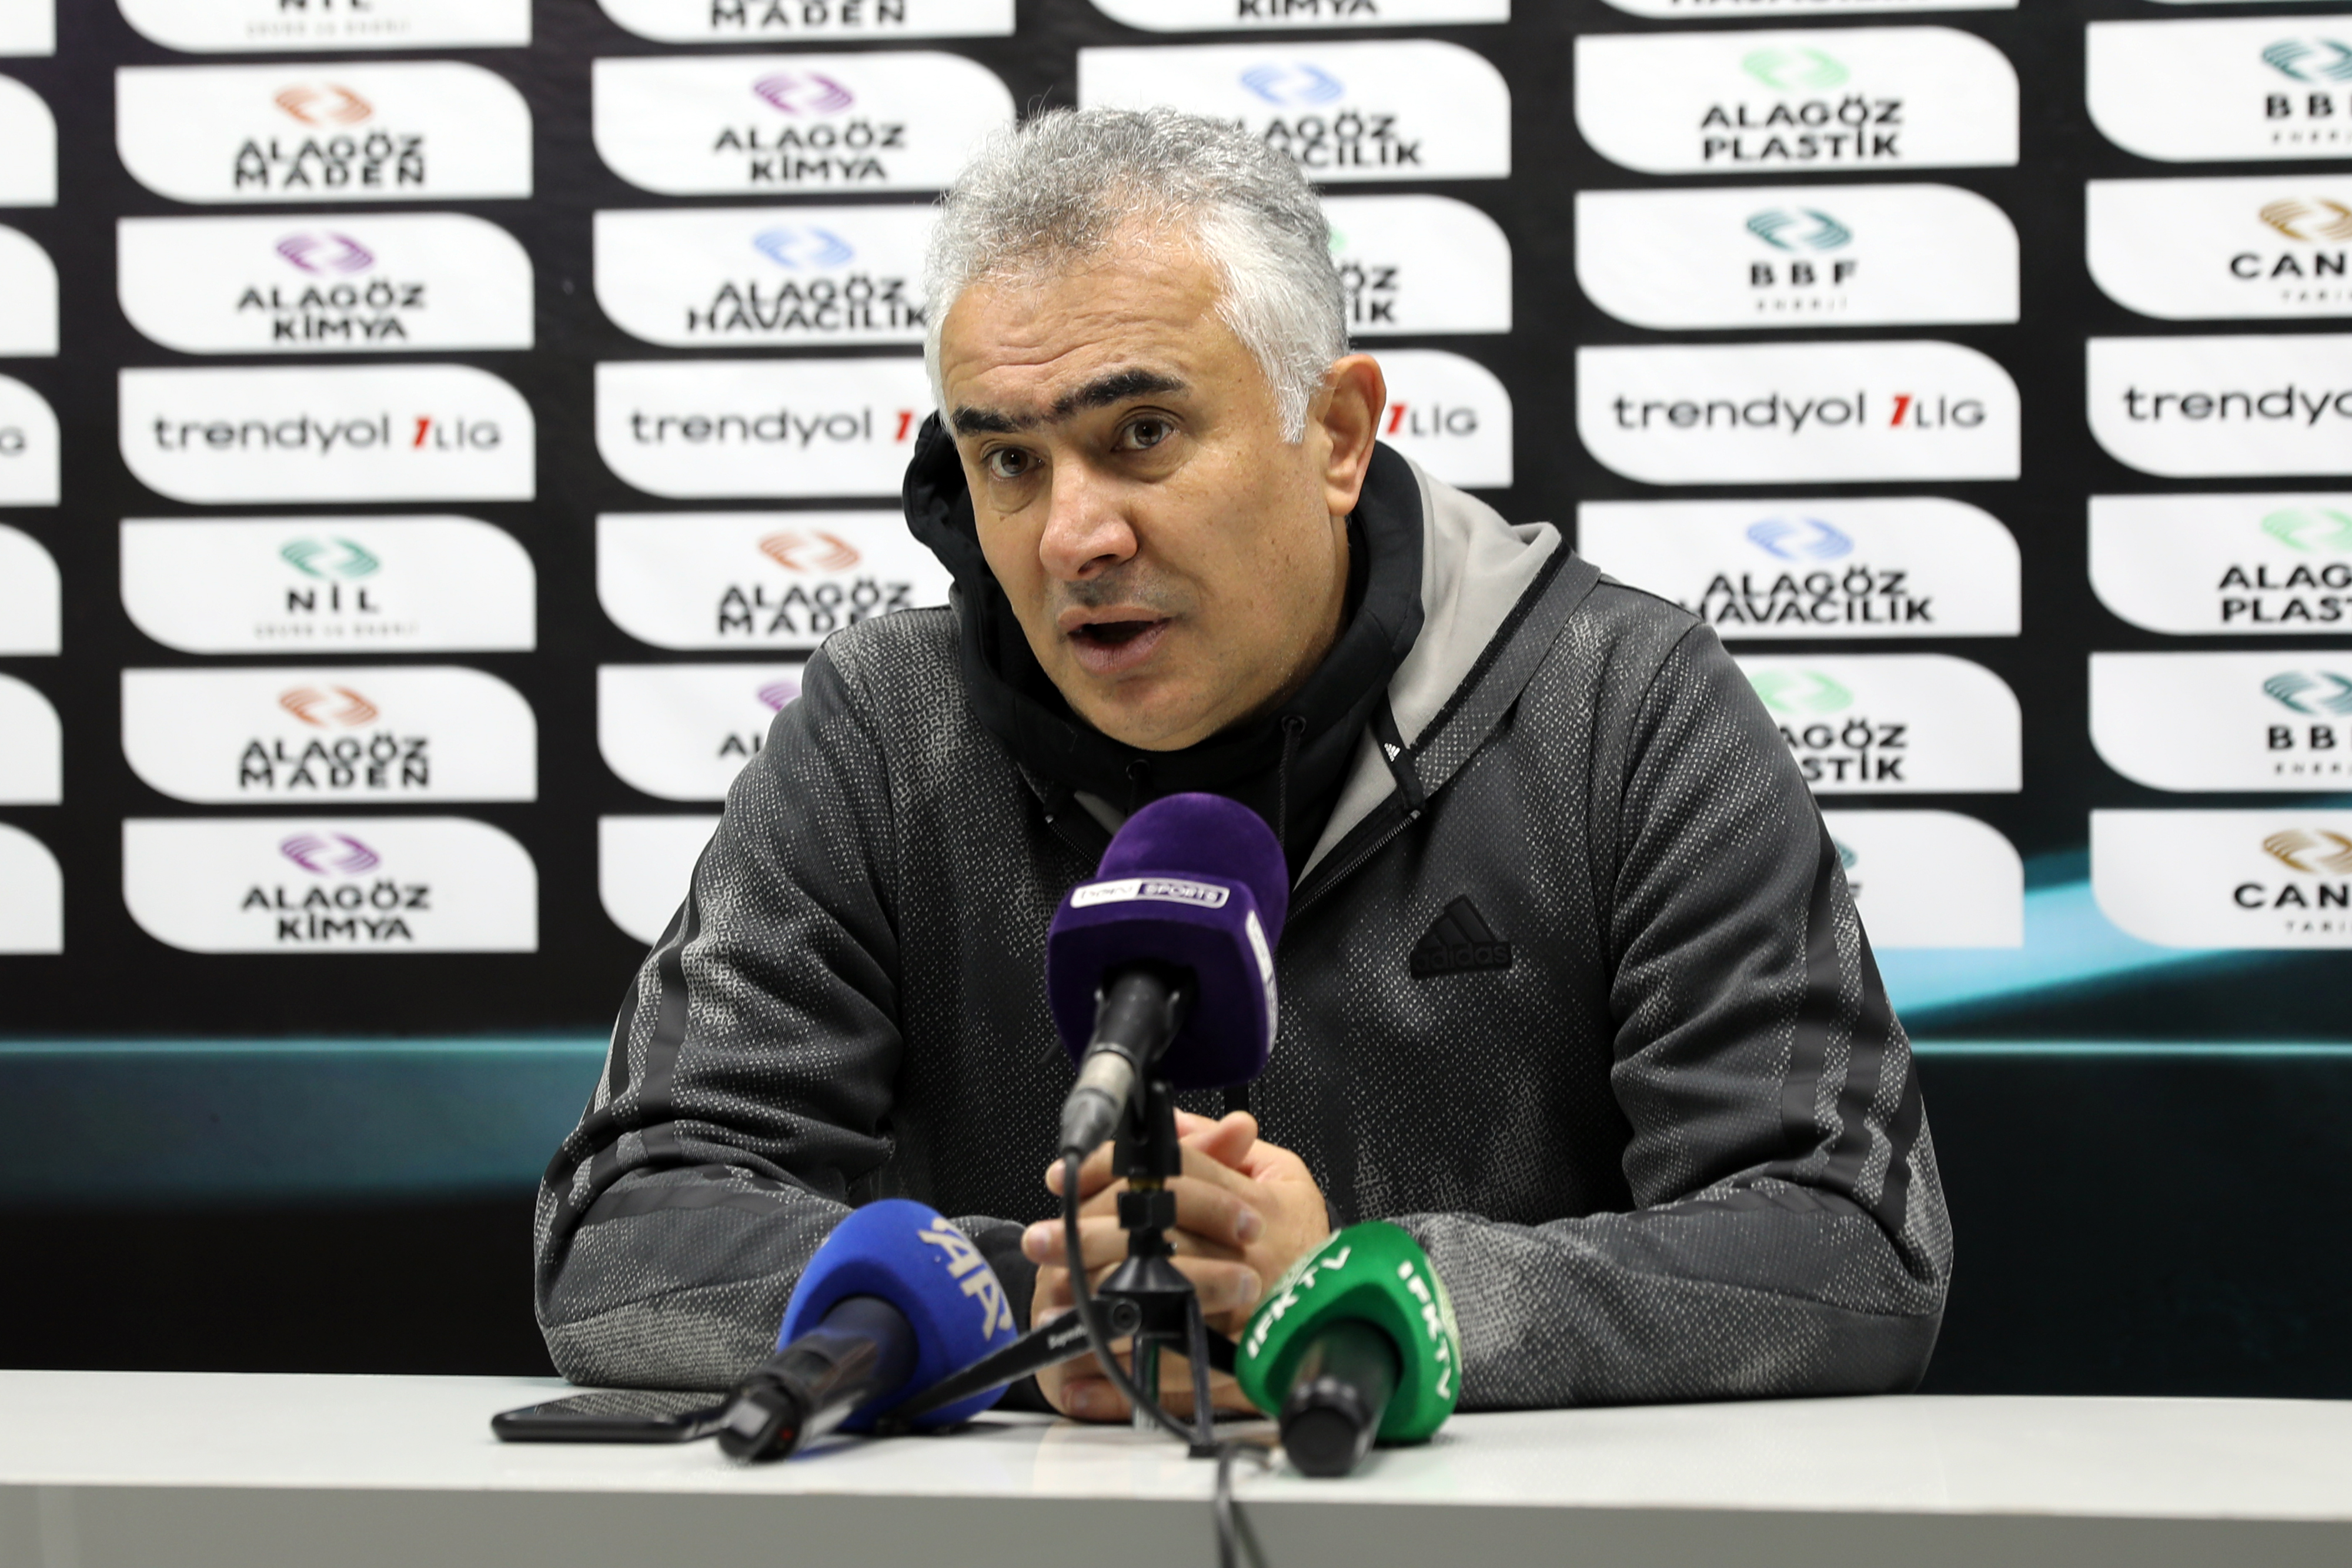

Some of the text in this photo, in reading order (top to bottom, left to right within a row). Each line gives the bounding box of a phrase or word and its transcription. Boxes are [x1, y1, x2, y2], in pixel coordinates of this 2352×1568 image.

[710, 0, 906, 28] MADEN
[1700, 95, 1903, 130] ALAGÖZ
[2266, 93, 2352, 119] BB
[713, 121, 906, 152] ALAGÖZ
[1263, 111, 1397, 141] AGÖZ
[236, 132, 425, 163] ALAGÖZ
[1703, 129, 1900, 163] PLASTİK
[233, 158, 426, 190] MADEN
[750, 154, 887, 183] KİMYA
[1749, 260, 1857, 287] BBF
[236, 280, 426, 312] ALAGÖZ
[713, 276, 906, 306] ALAGÖZ
[272, 311, 408, 342] KİMYA
[1612, 390, 1866, 434] trendyol
[152, 413, 391, 455] trendyol
[629, 407, 873, 449] trendyol
[718, 579, 913, 609] ALAGÖZ
[1705, 566, 1908, 597] ALAGÖZ
[286, 583, 379, 614] NİL
[719, 612, 863, 636] MAD
[241, 733, 430, 763] ALAGÖZ
[1779, 718, 1907, 750] AGÖZ
[2267, 724, 2352, 751] BB
[238, 758, 430, 789] MADEN
[1802, 750, 1904, 782] STİK
[241, 880, 431, 911] ALAGÖZ
[276, 911, 413, 941] KİMYA
[1413, 942, 1509, 973] adidas
